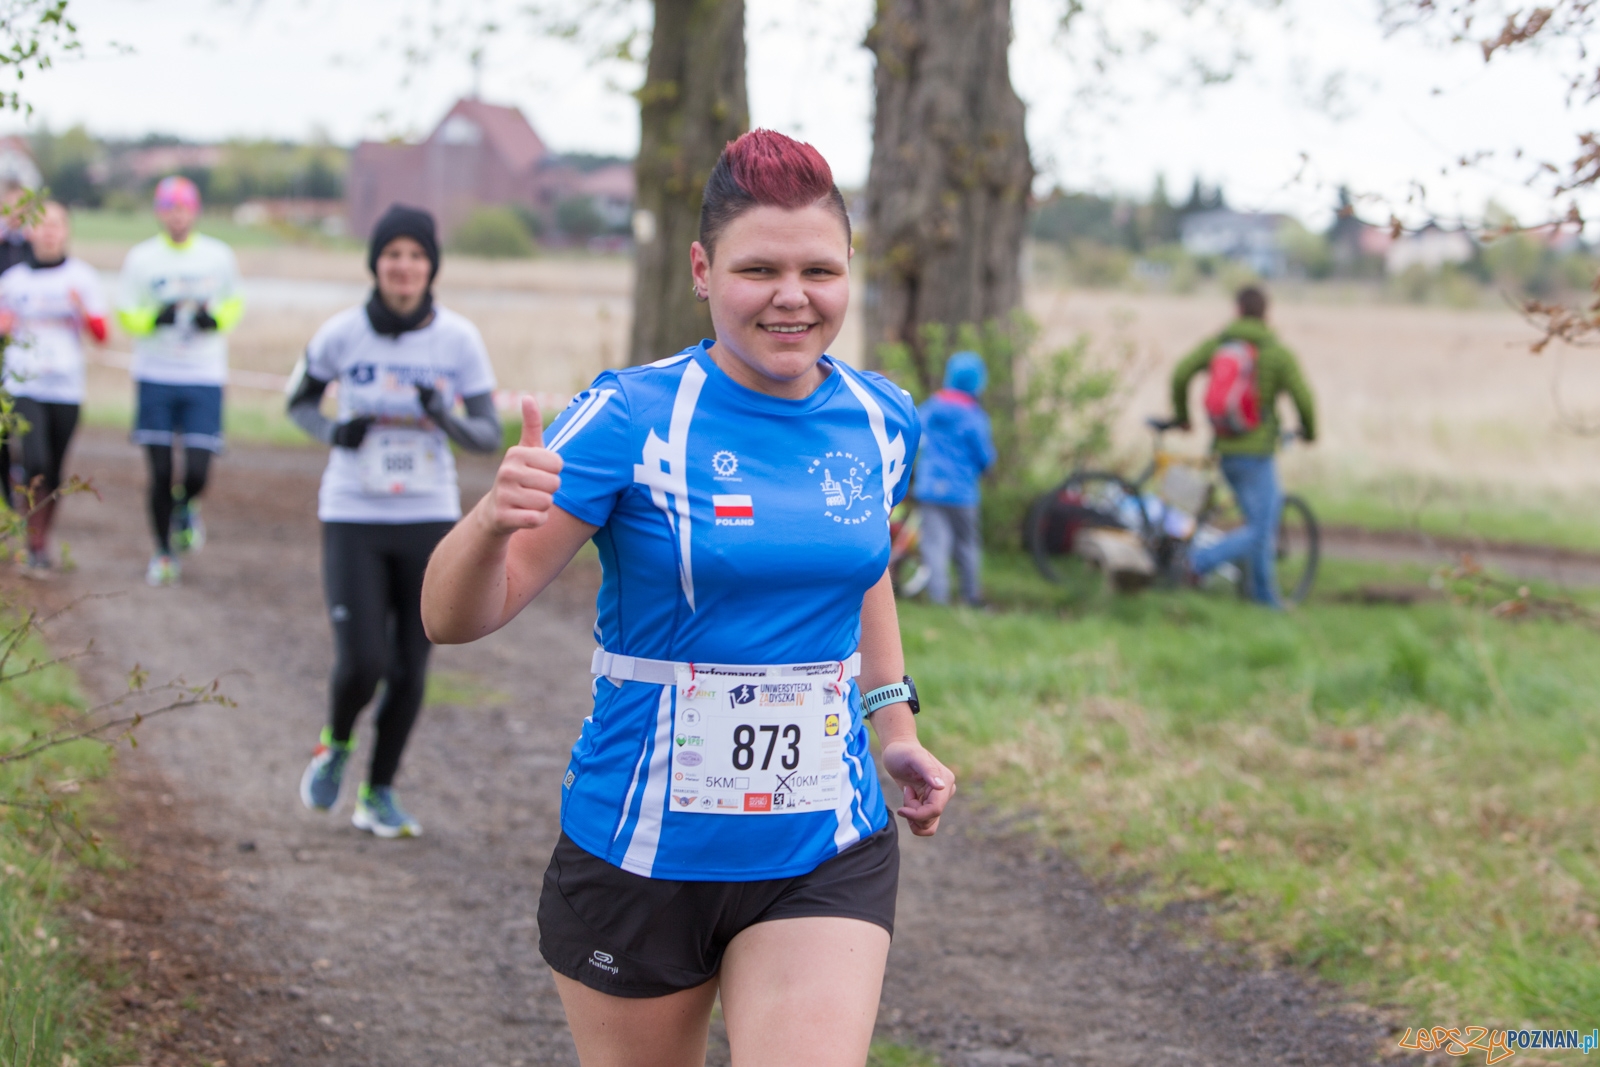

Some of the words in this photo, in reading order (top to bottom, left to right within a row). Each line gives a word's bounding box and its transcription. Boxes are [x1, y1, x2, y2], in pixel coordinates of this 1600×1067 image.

[715, 518, 755, 526] POLAND
[760, 682, 813, 693] UNIWERSYTECKA
[759, 692, 796, 703] ZADYSZKA
[796, 692, 805, 706] IV
[731, 723, 801, 771] 873
[705, 777, 734, 789] 5KM
[791, 775, 819, 787] 10KM
[588, 957, 619, 975] Kalenji
